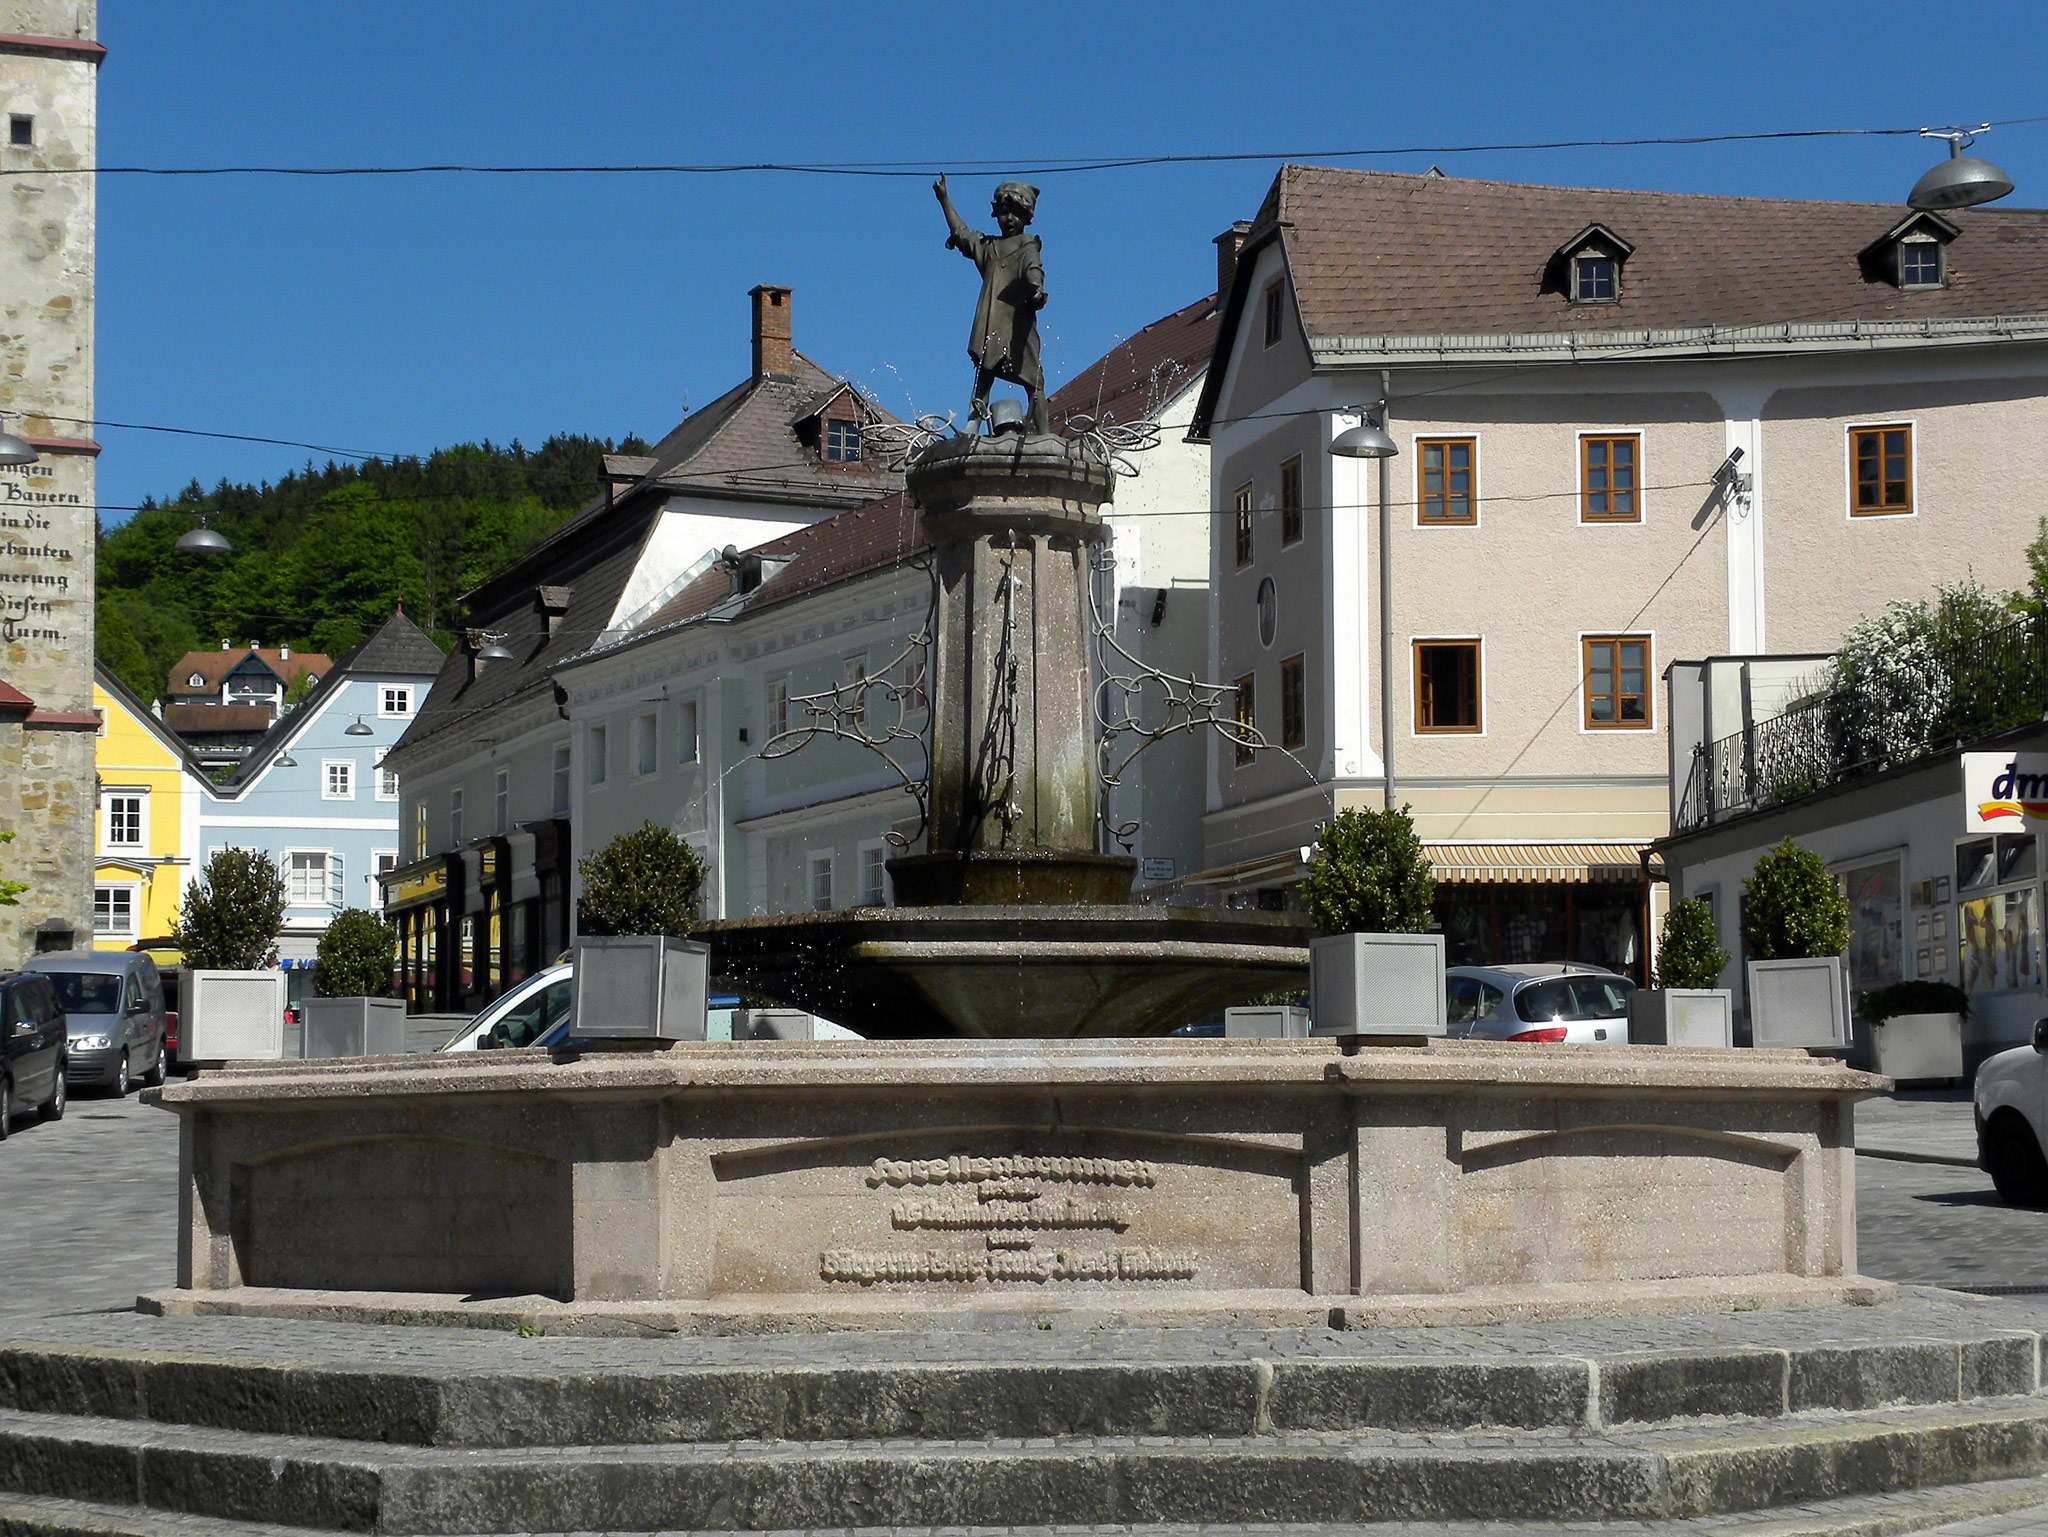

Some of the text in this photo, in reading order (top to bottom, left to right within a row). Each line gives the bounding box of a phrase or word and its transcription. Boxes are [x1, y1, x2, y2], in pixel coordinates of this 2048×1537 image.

[1, 482, 81, 504] Bauern
[24, 509, 51, 530] die
[1991, 763, 2048, 800] dm
